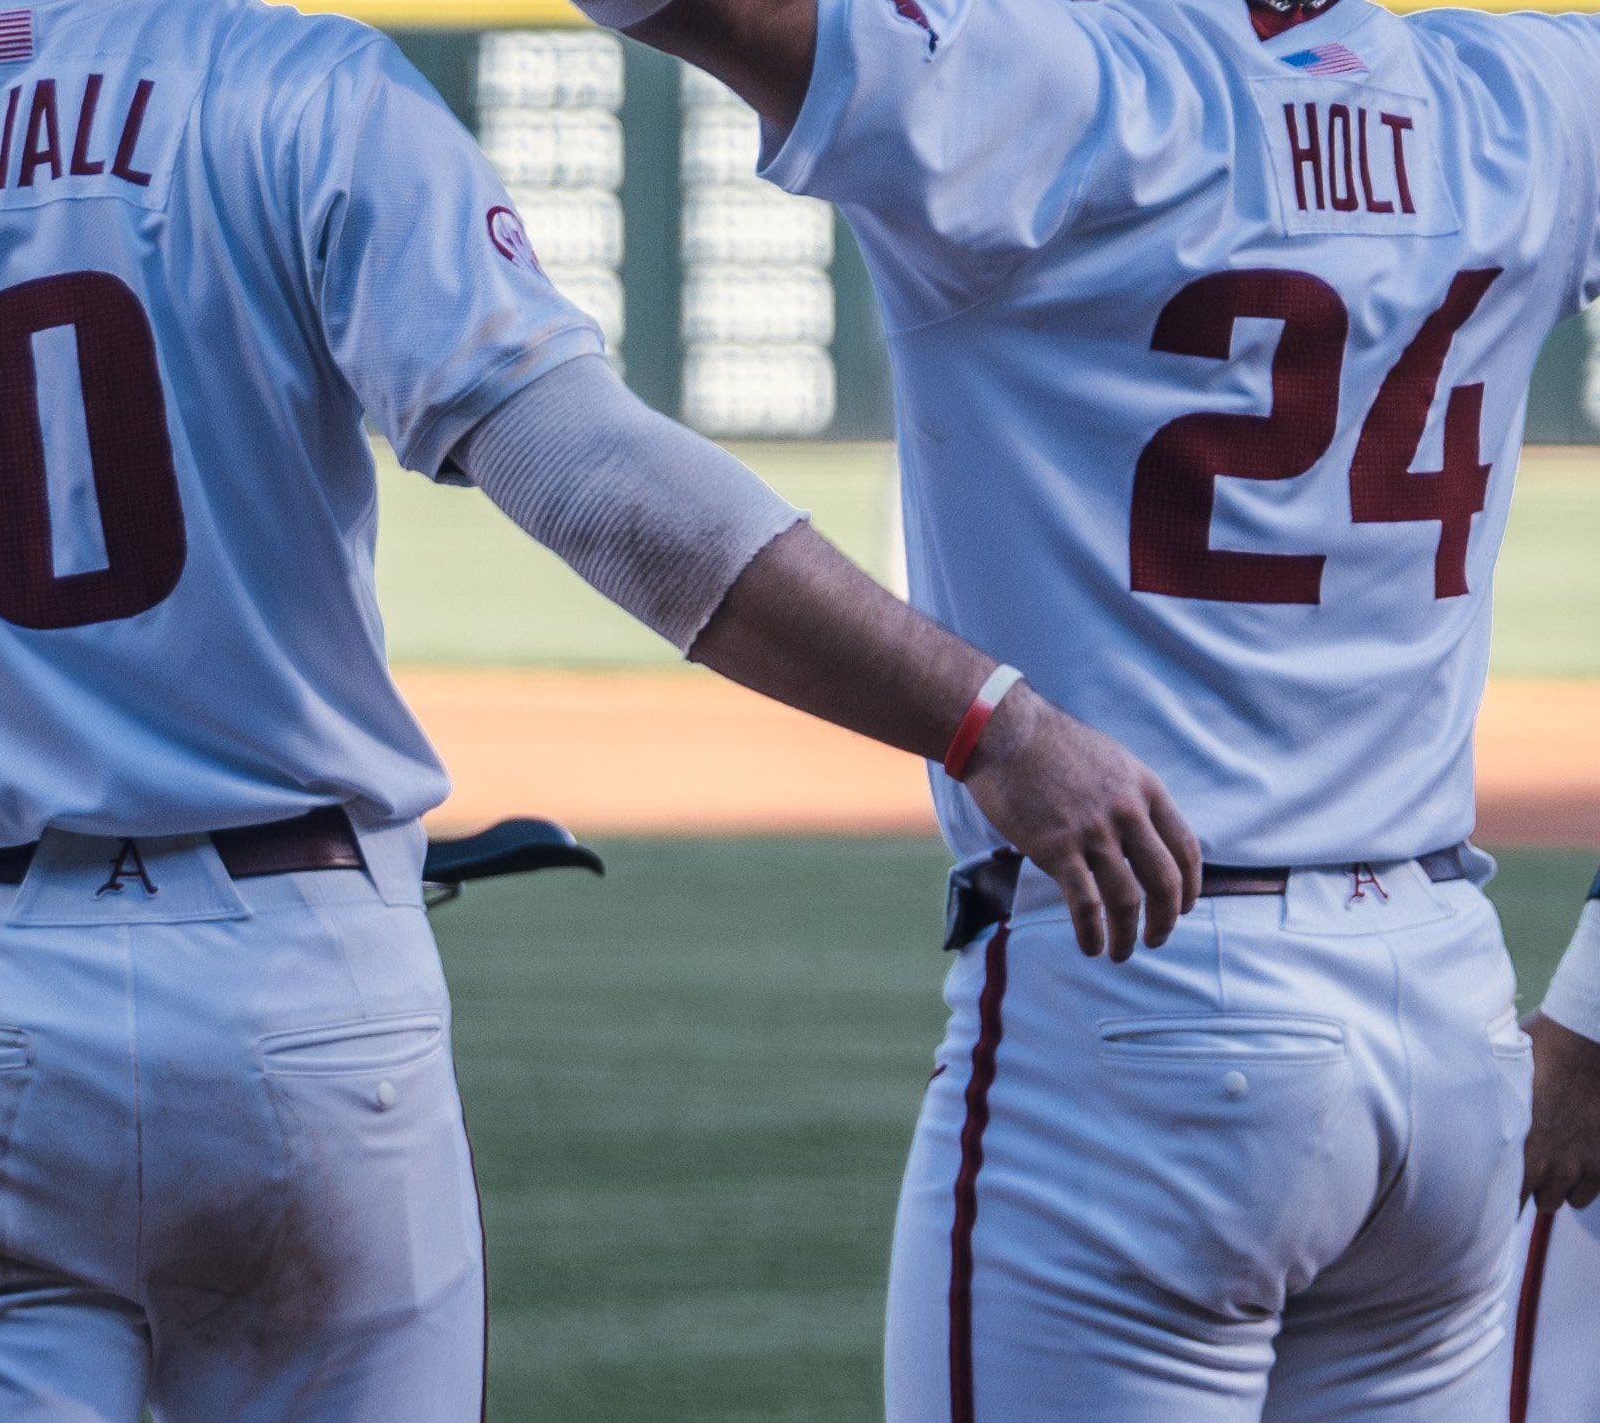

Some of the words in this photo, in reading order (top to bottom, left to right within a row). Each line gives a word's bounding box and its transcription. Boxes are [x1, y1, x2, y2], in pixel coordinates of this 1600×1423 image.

[1283, 101, 1417, 215] HOLT
[1130, 267, 1505, 605] 24
[95, 837, 159, 900] A
